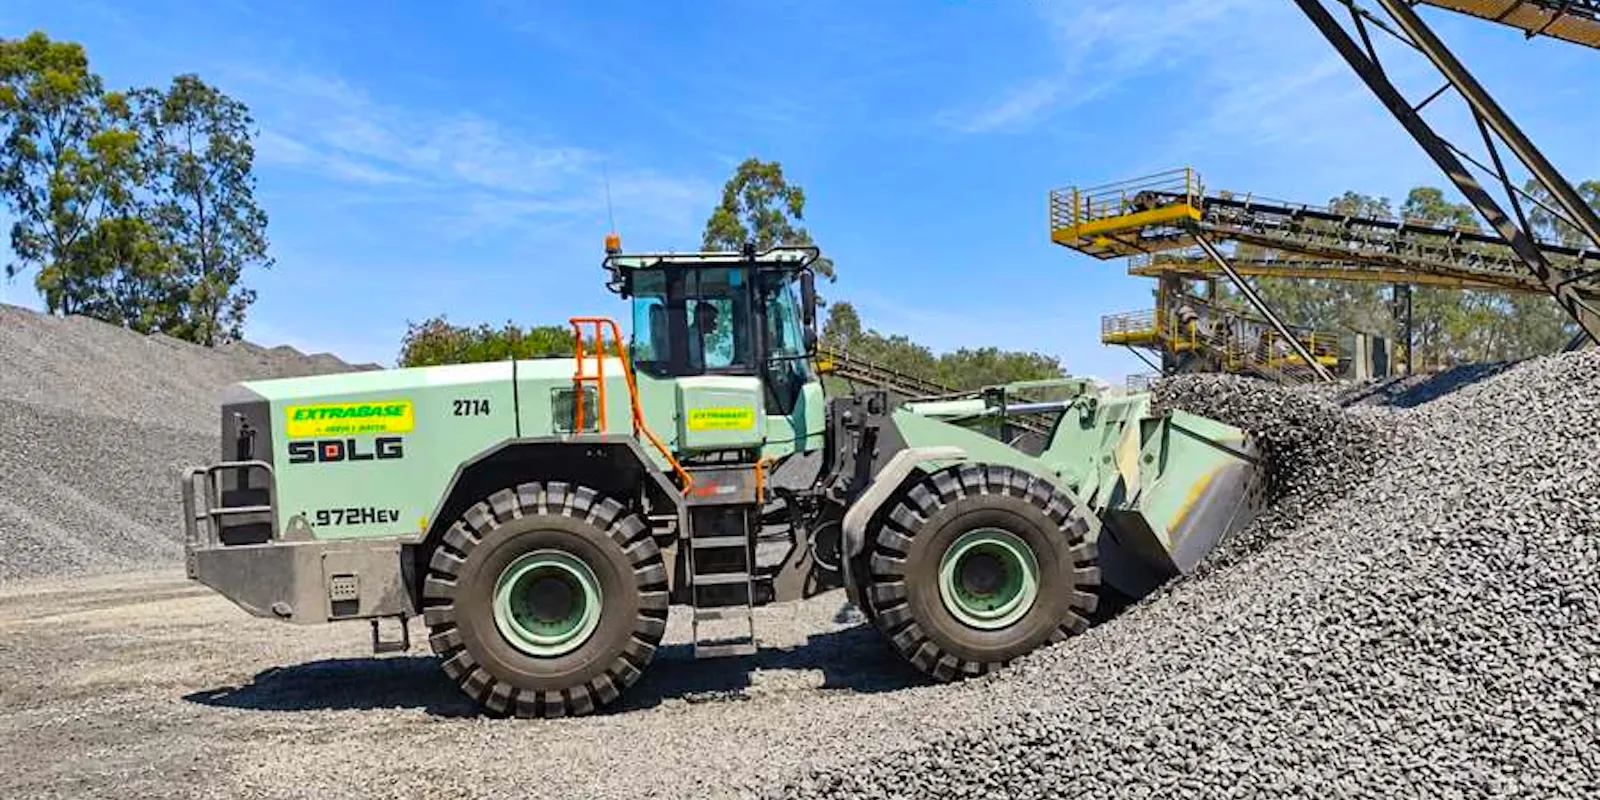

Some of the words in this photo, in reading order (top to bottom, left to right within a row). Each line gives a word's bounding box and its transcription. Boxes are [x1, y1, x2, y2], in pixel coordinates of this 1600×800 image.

[293, 404, 407, 420] EXTRABASE
[453, 400, 490, 416] 2714
[288, 437, 403, 463] SDLG
[301, 508, 399, 527] 972HEV
